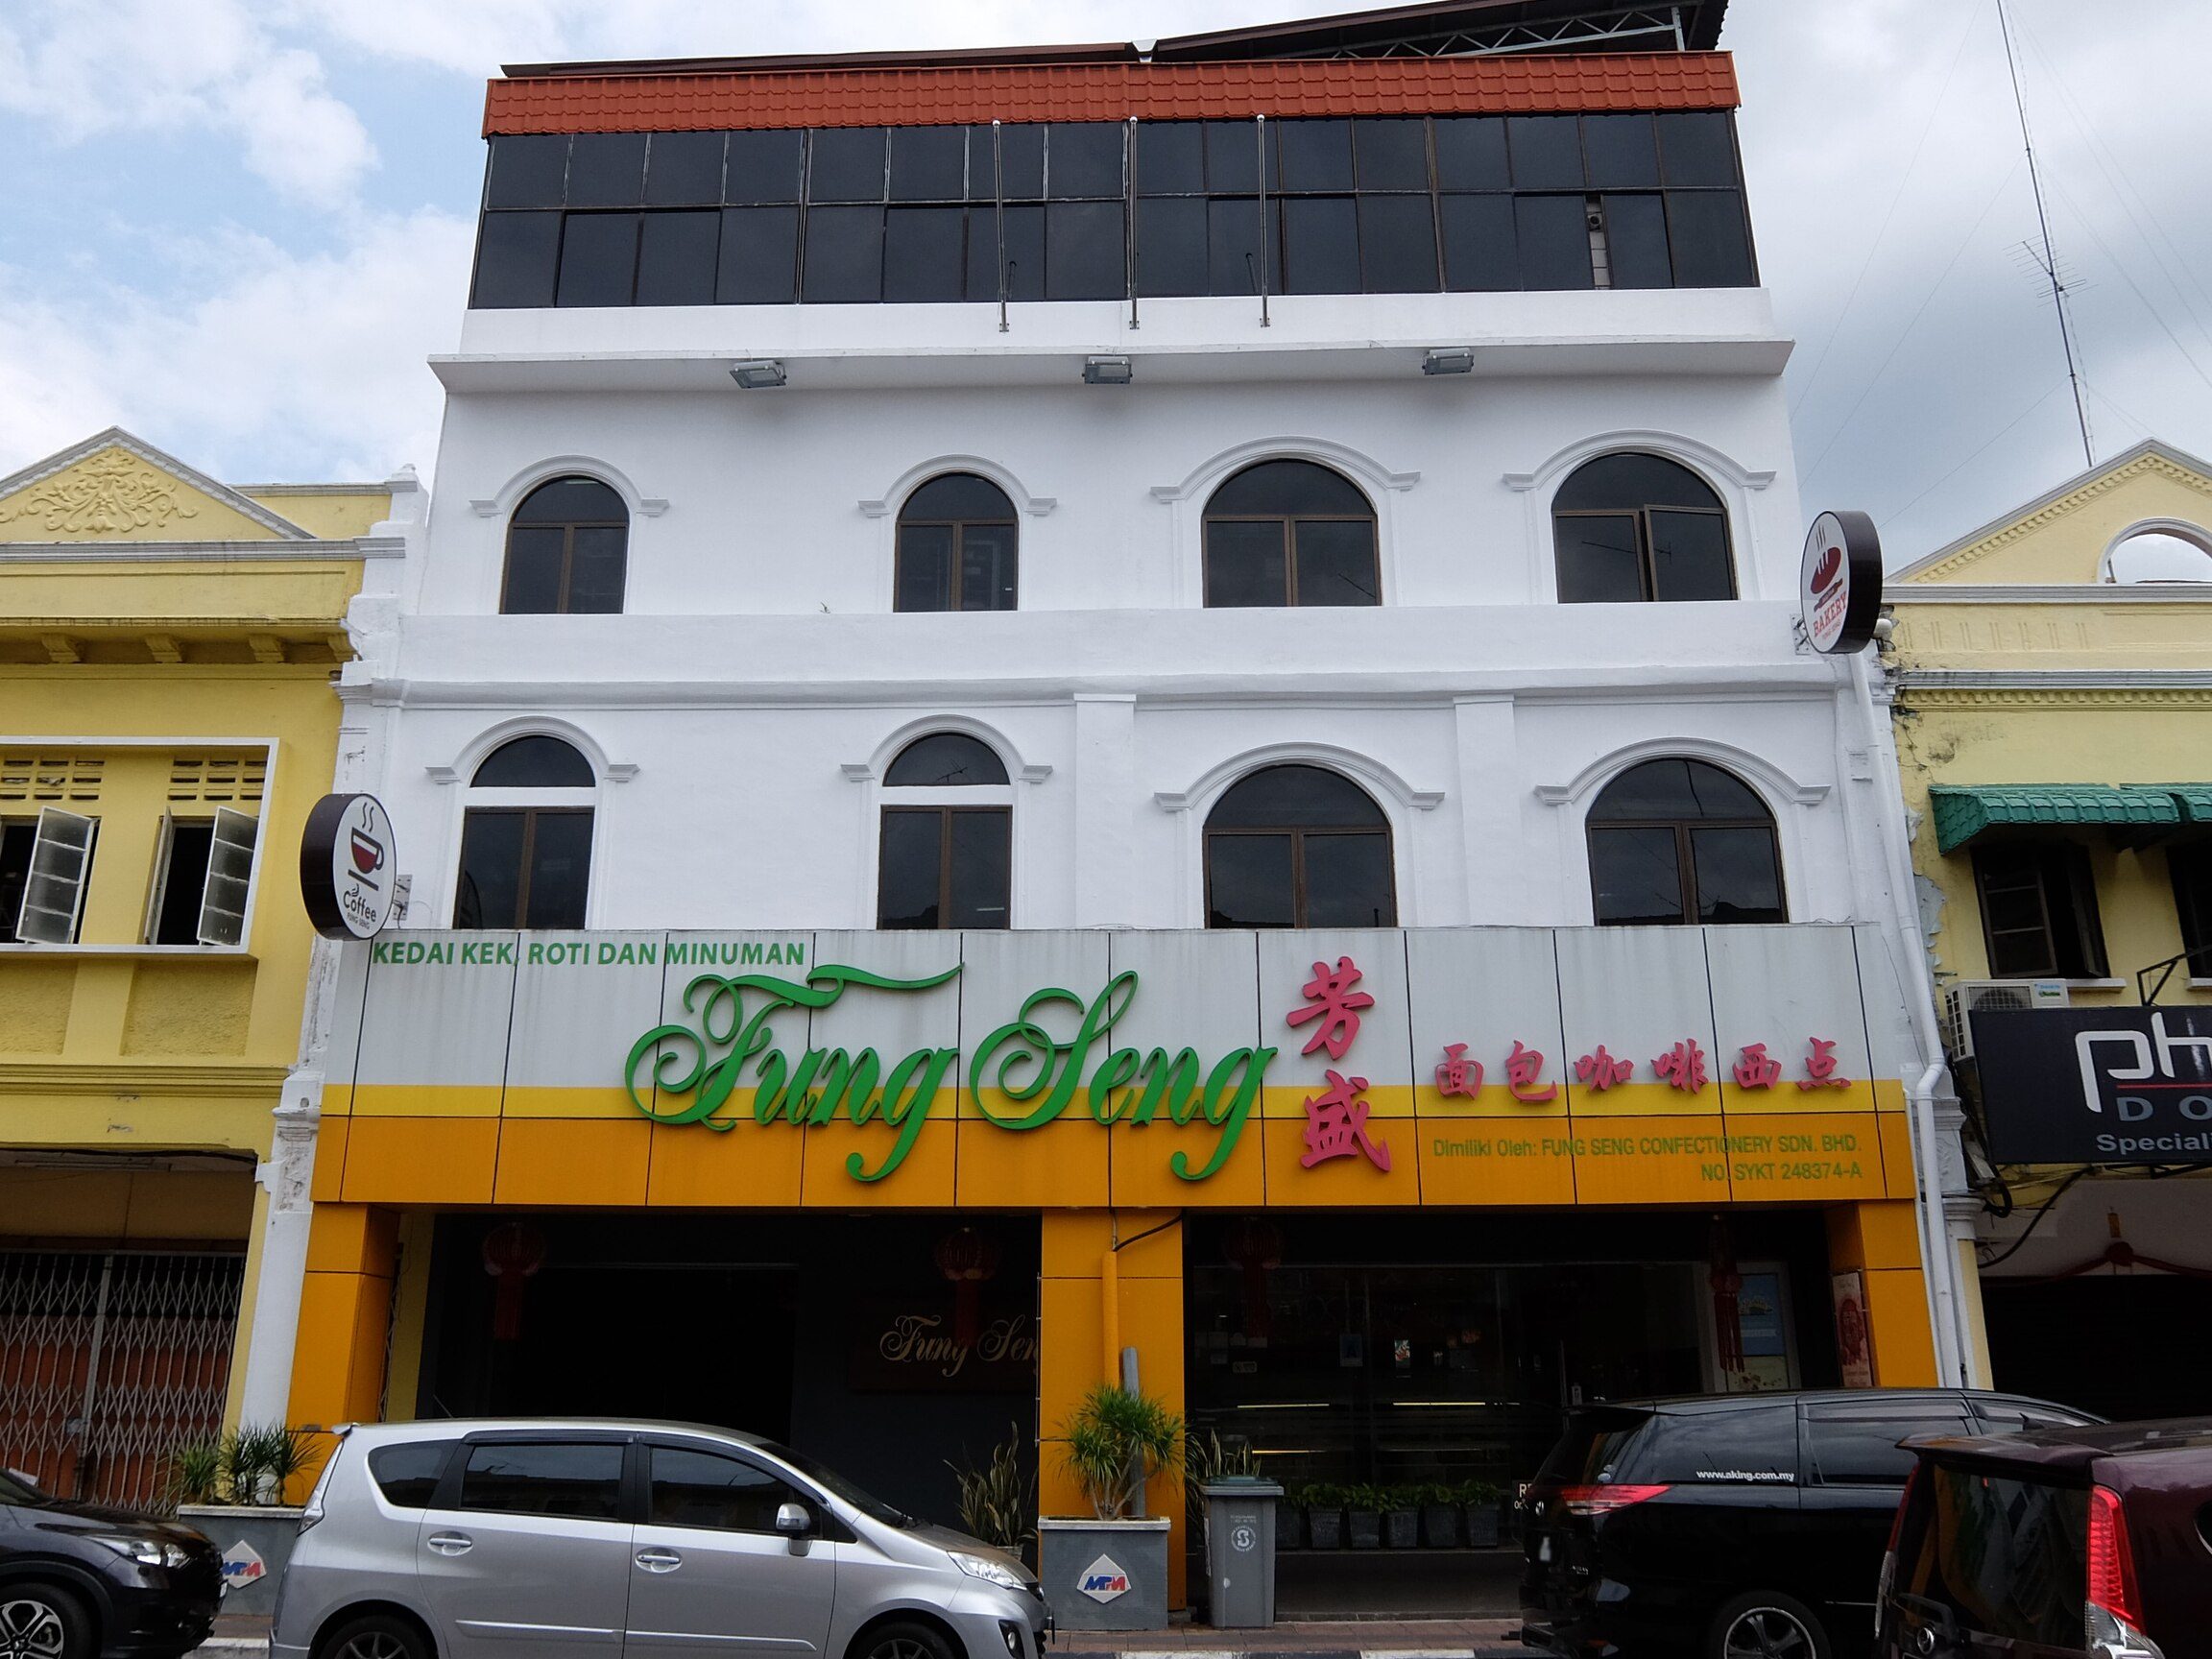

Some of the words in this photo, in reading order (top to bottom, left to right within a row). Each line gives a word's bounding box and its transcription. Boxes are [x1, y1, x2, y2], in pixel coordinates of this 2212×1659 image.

[1813, 590, 1846, 637] BAKERY
[343, 889, 377, 923] Coffee
[373, 942, 454, 965] KEDAI
[461, 943, 519, 966] KEK,
[528, 943, 589, 965] ROTI
[597, 943, 656, 965] DAN
[666, 943, 805, 966] MINUMAN
[624, 962, 964, 1182] Fung
[969, 970, 1279, 1181] Seng
[1286, 955, 1391, 1172] 芳盛
[1433, 1140, 1491, 1157] Dimiliki
[1497, 1140, 1536, 1157] Oleh:
[1542, 1139, 1586, 1156] FUNG
[1590, 1138, 1636, 1156] SENG
[1640, 1136, 1773, 1155] CONFECTIONERY
[1778, 1135, 1817, 1153] SDN.
[1822, 1134, 1862, 1152] BHD.
[2096, 1133, 2212, 1156] Special
[1735, 1163, 1775, 1181] SYKT
[1782, 1162, 1863, 1180] 248374-A
[879, 1315, 969, 1377] Fung
[976, 1313, 1038, 1376] Sen
[1696, 1471, 1794, 1481] www.aking.com.my
